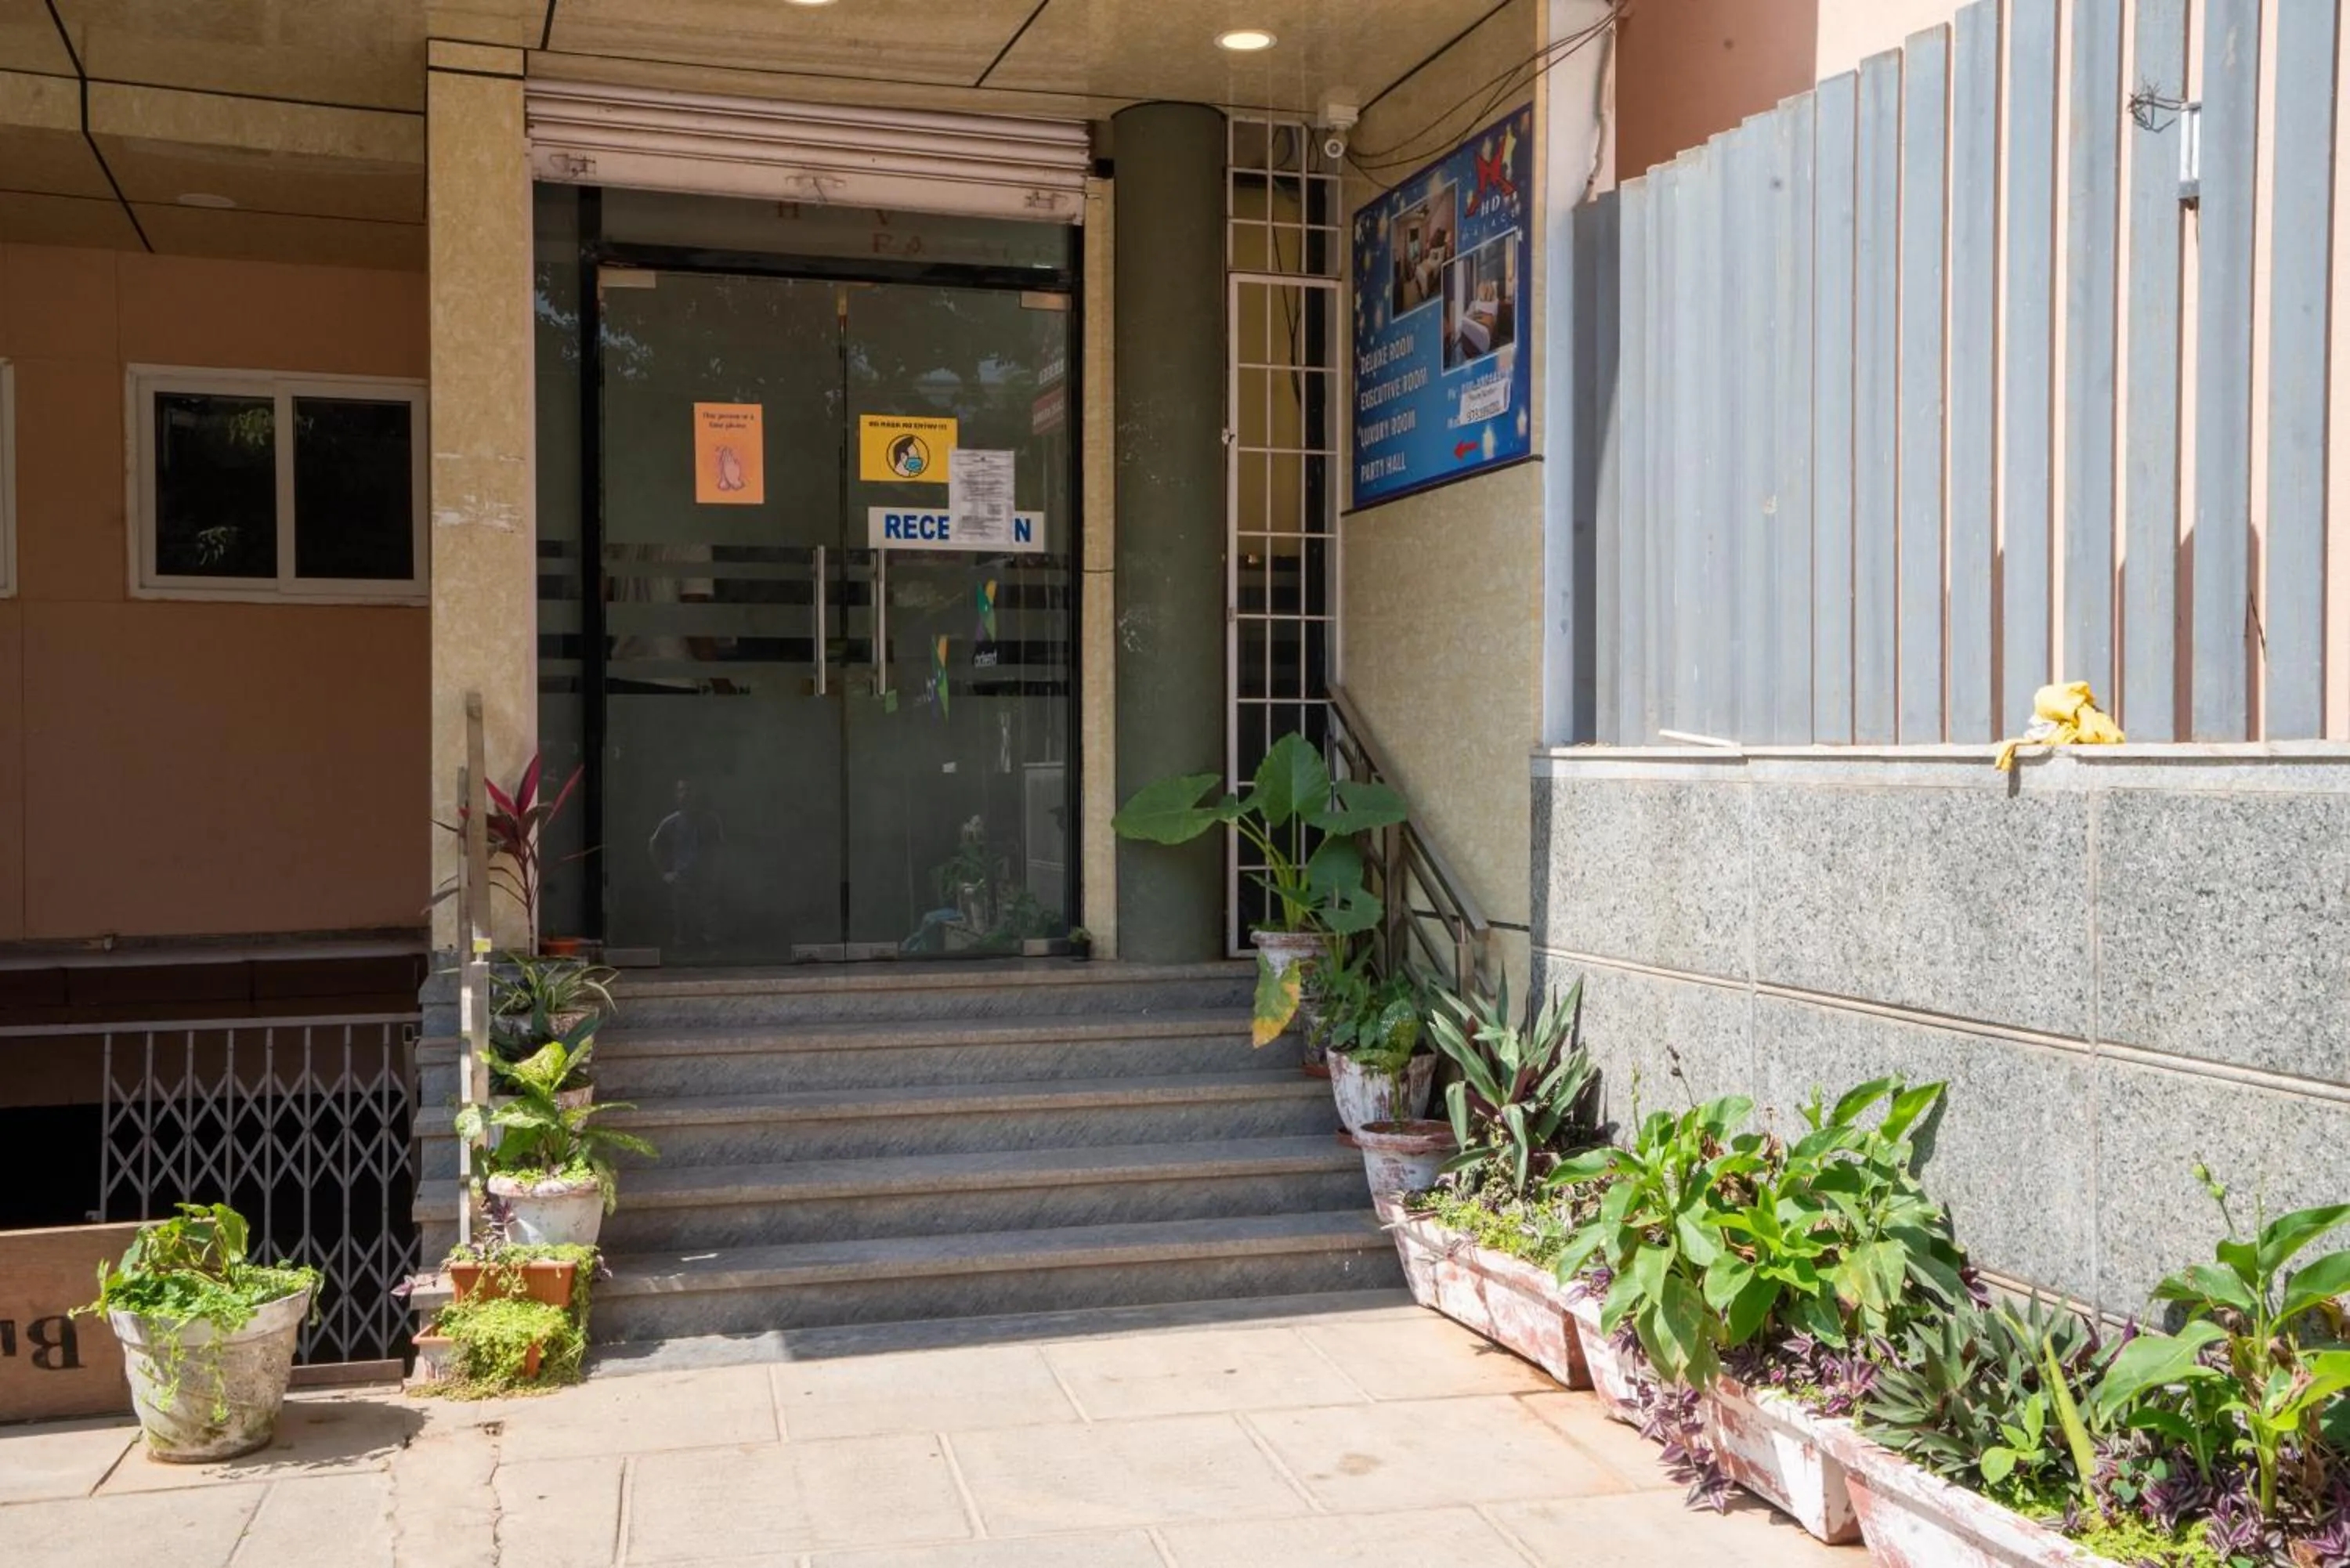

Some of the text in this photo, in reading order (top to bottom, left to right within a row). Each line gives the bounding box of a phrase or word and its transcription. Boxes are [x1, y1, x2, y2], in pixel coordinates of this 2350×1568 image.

[1360, 335, 1415, 375] DELUXE ROOM
[1361, 377, 1401, 411] EXECUTIVE
[1402, 367, 1428, 393] ROOM
[1360, 421, 1389, 449] LUXURY
[1390, 409, 1415, 435] ROOM
[1361, 450, 1407, 484] PARTY HALL
[884, 513, 1032, 543] RECEN
